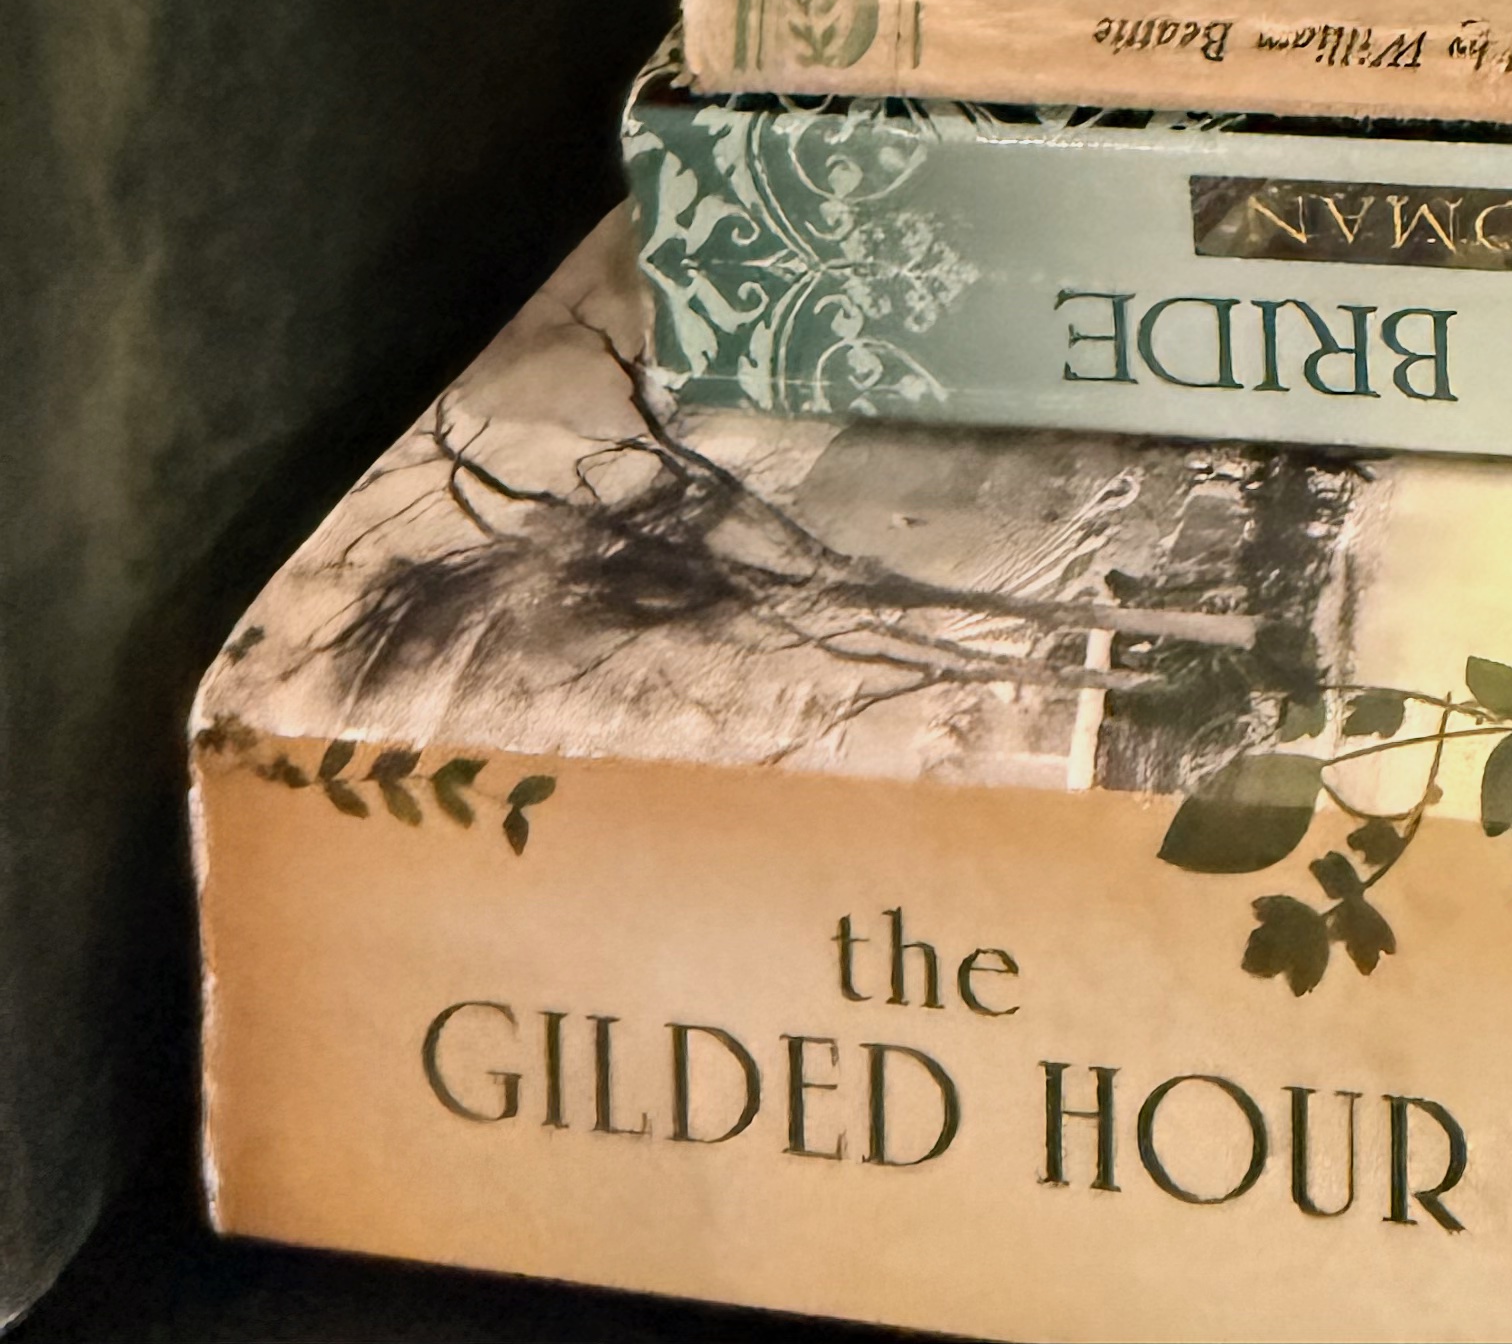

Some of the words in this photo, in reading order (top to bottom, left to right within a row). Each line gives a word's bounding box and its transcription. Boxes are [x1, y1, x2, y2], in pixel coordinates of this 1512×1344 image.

[1257, 22, 1428, 71] William
[1053, 289, 1459, 403] BRIDE
[831, 905, 1021, 1017] the
[418, 998, 962, 1169] GILDED
[1035, 1057, 1470, 1236] HOUR
